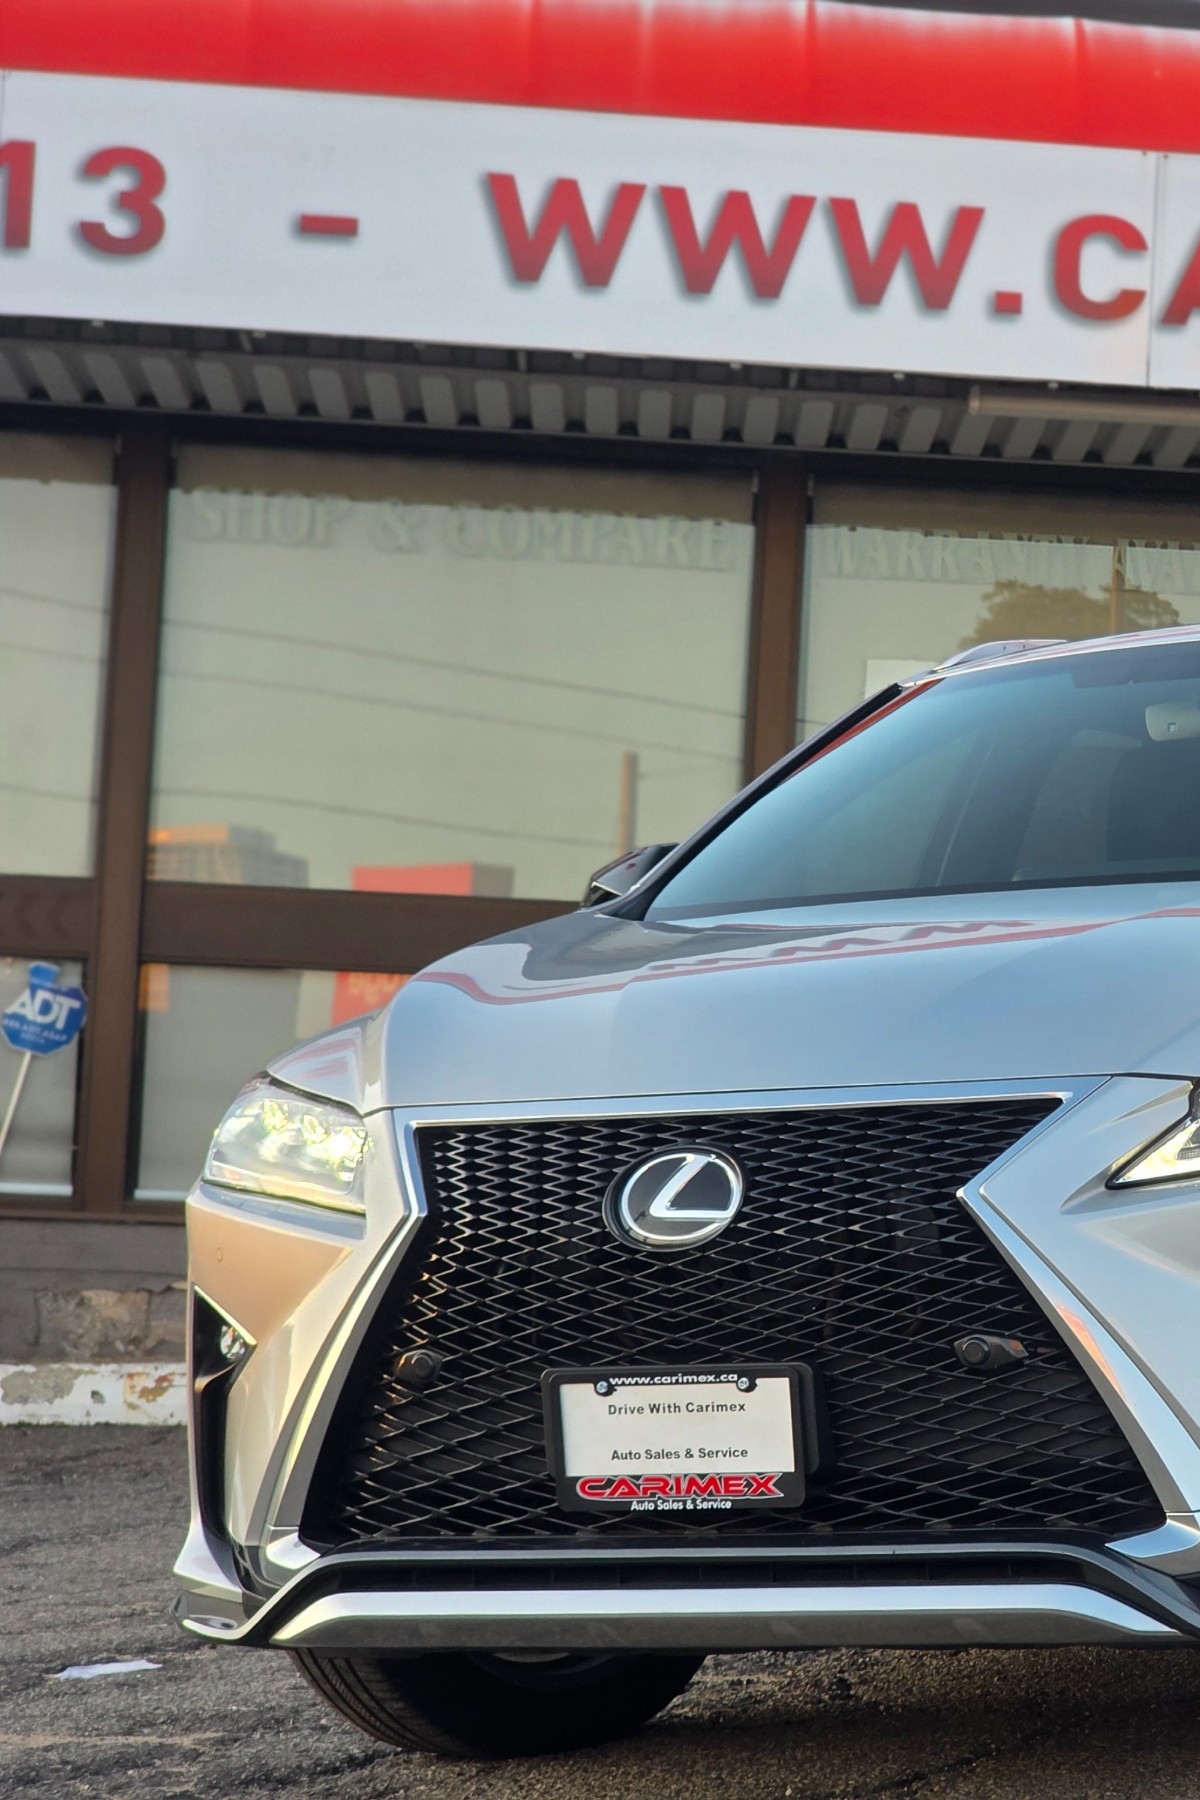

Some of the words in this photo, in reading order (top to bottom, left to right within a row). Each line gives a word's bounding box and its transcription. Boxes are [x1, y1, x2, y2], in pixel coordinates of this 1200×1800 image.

[192, 485, 350, 547] SHOP
[444, 501, 738, 572] COMPARE
[4, 988, 81, 1030] ADT
[609, 1373, 738, 1385] www.carimex.ca
[608, 1403, 645, 1416] Drive
[649, 1402, 681, 1414] With
[685, 1401, 746, 1413] Carimex
[611, 1449, 641, 1461] Auto
[645, 1448, 681, 1460] Sales
[684, 1448, 695, 1459] &
[698, 1446, 749, 1459] Service
[576, 1473, 783, 1499] CARIMEX
[630, 1499, 654, 1512] Auto
[656, 1499, 684, 1511] Sales
[686, 1498, 696, 1510] &
[696, 1497, 732, 1510] Service
